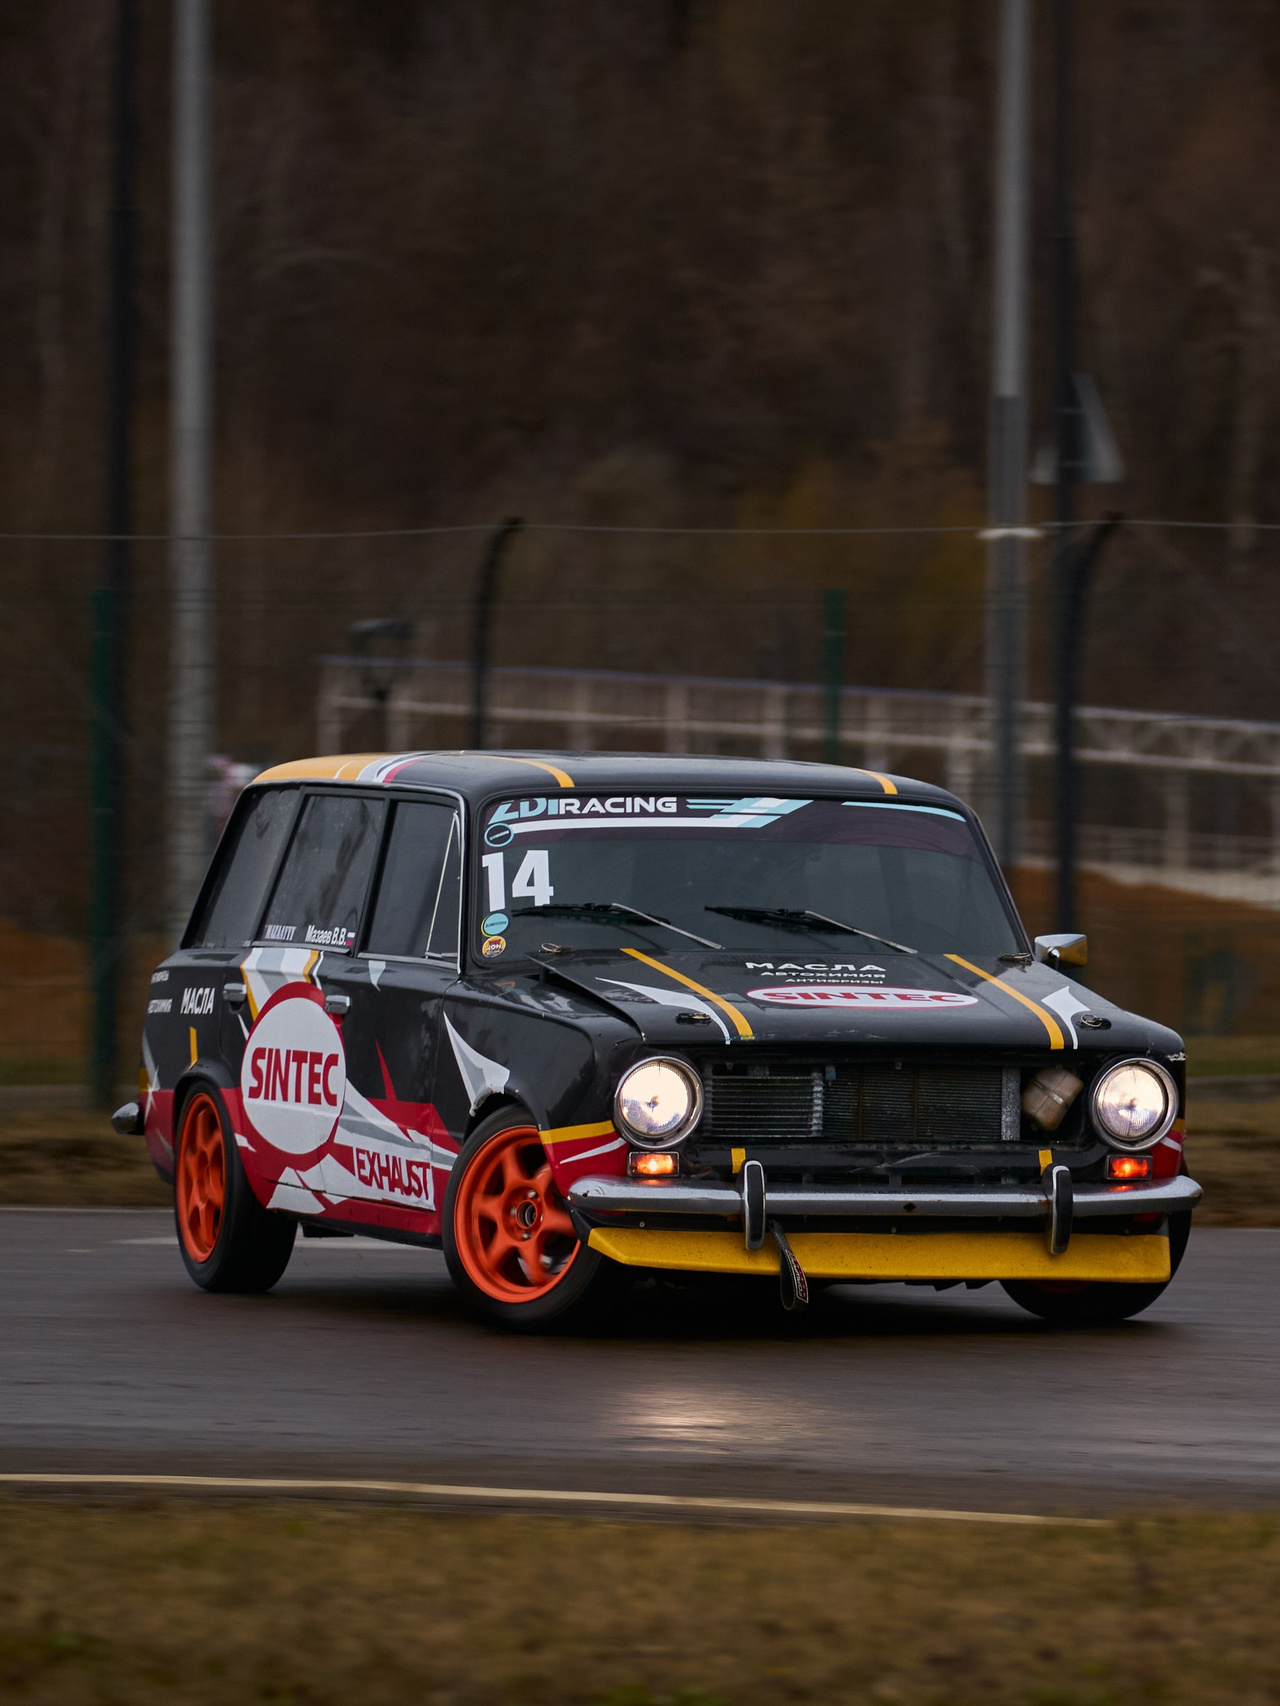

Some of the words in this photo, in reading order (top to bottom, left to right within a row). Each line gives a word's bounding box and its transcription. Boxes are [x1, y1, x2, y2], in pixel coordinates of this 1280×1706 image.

[482, 850, 554, 912] 14
[745, 962, 886, 972] МАСЛА
[180, 987, 215, 1014] МАСЛА
[763, 992, 965, 1002] SINTEC
[248, 1047, 340, 1107] SINTEC
[356, 1147, 431, 1200] EXHAUST
